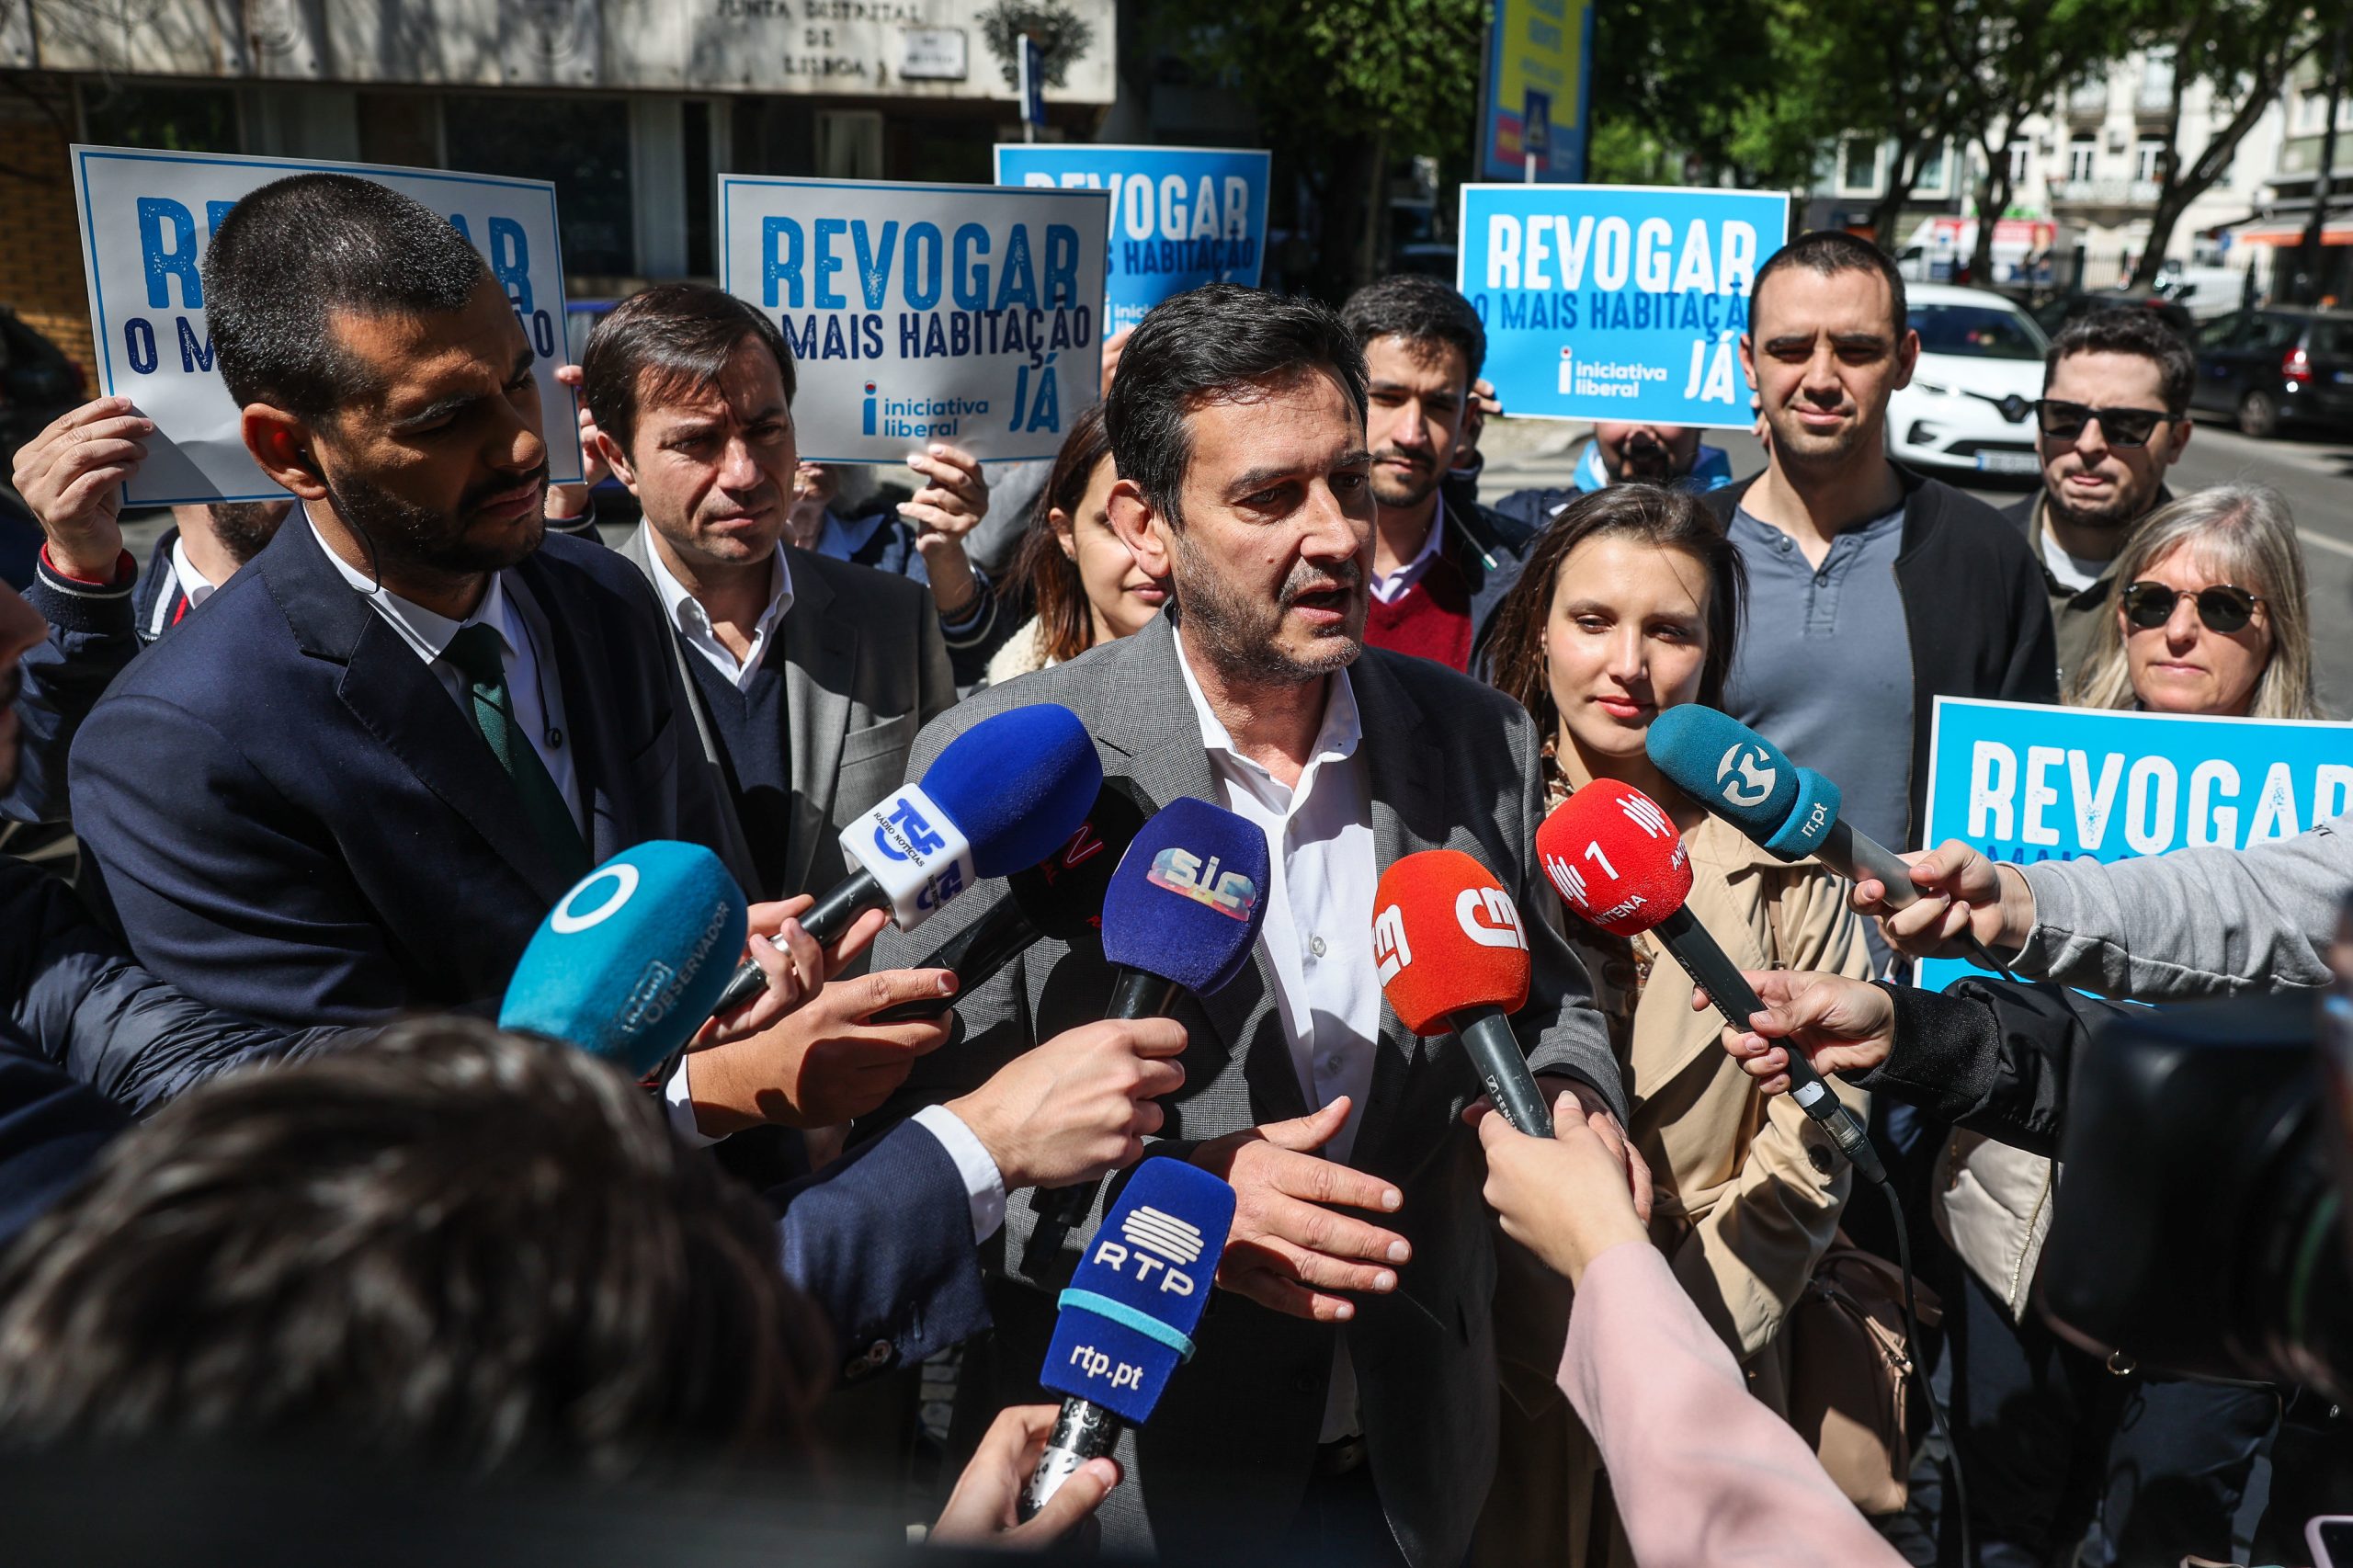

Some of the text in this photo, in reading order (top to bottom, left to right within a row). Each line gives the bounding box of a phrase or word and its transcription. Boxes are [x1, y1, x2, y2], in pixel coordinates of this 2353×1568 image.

[763, 216, 1079, 312] REVOGAR
[1487, 214, 1757, 297] REVOGAR
[782, 293, 1090, 369] MAIS HABITAÇÃO
[1501, 292, 1578, 329] MAIS
[1590, 282, 1745, 345] HABITAÇÃ
[124, 317, 158, 374] O
[1575, 360, 1667, 381] iniciativa
[1684, 330, 1735, 404] JÁ
[884, 397, 989, 416] iniciativa
[1009, 352, 1060, 434] JÁ
[1575, 378, 1639, 398] liberal
[884, 419, 958, 437] liberal
[873, 812, 926, 868] RÁDIO NOTÍCIAS
[1801, 802, 1828, 837] rr.pt
[1585, 841, 1620, 880] 1
[1591, 894, 1648, 926] ANTENA
[1093, 1240, 1195, 1296] RTP
[1069, 1345, 1144, 1391] rtp.pt
